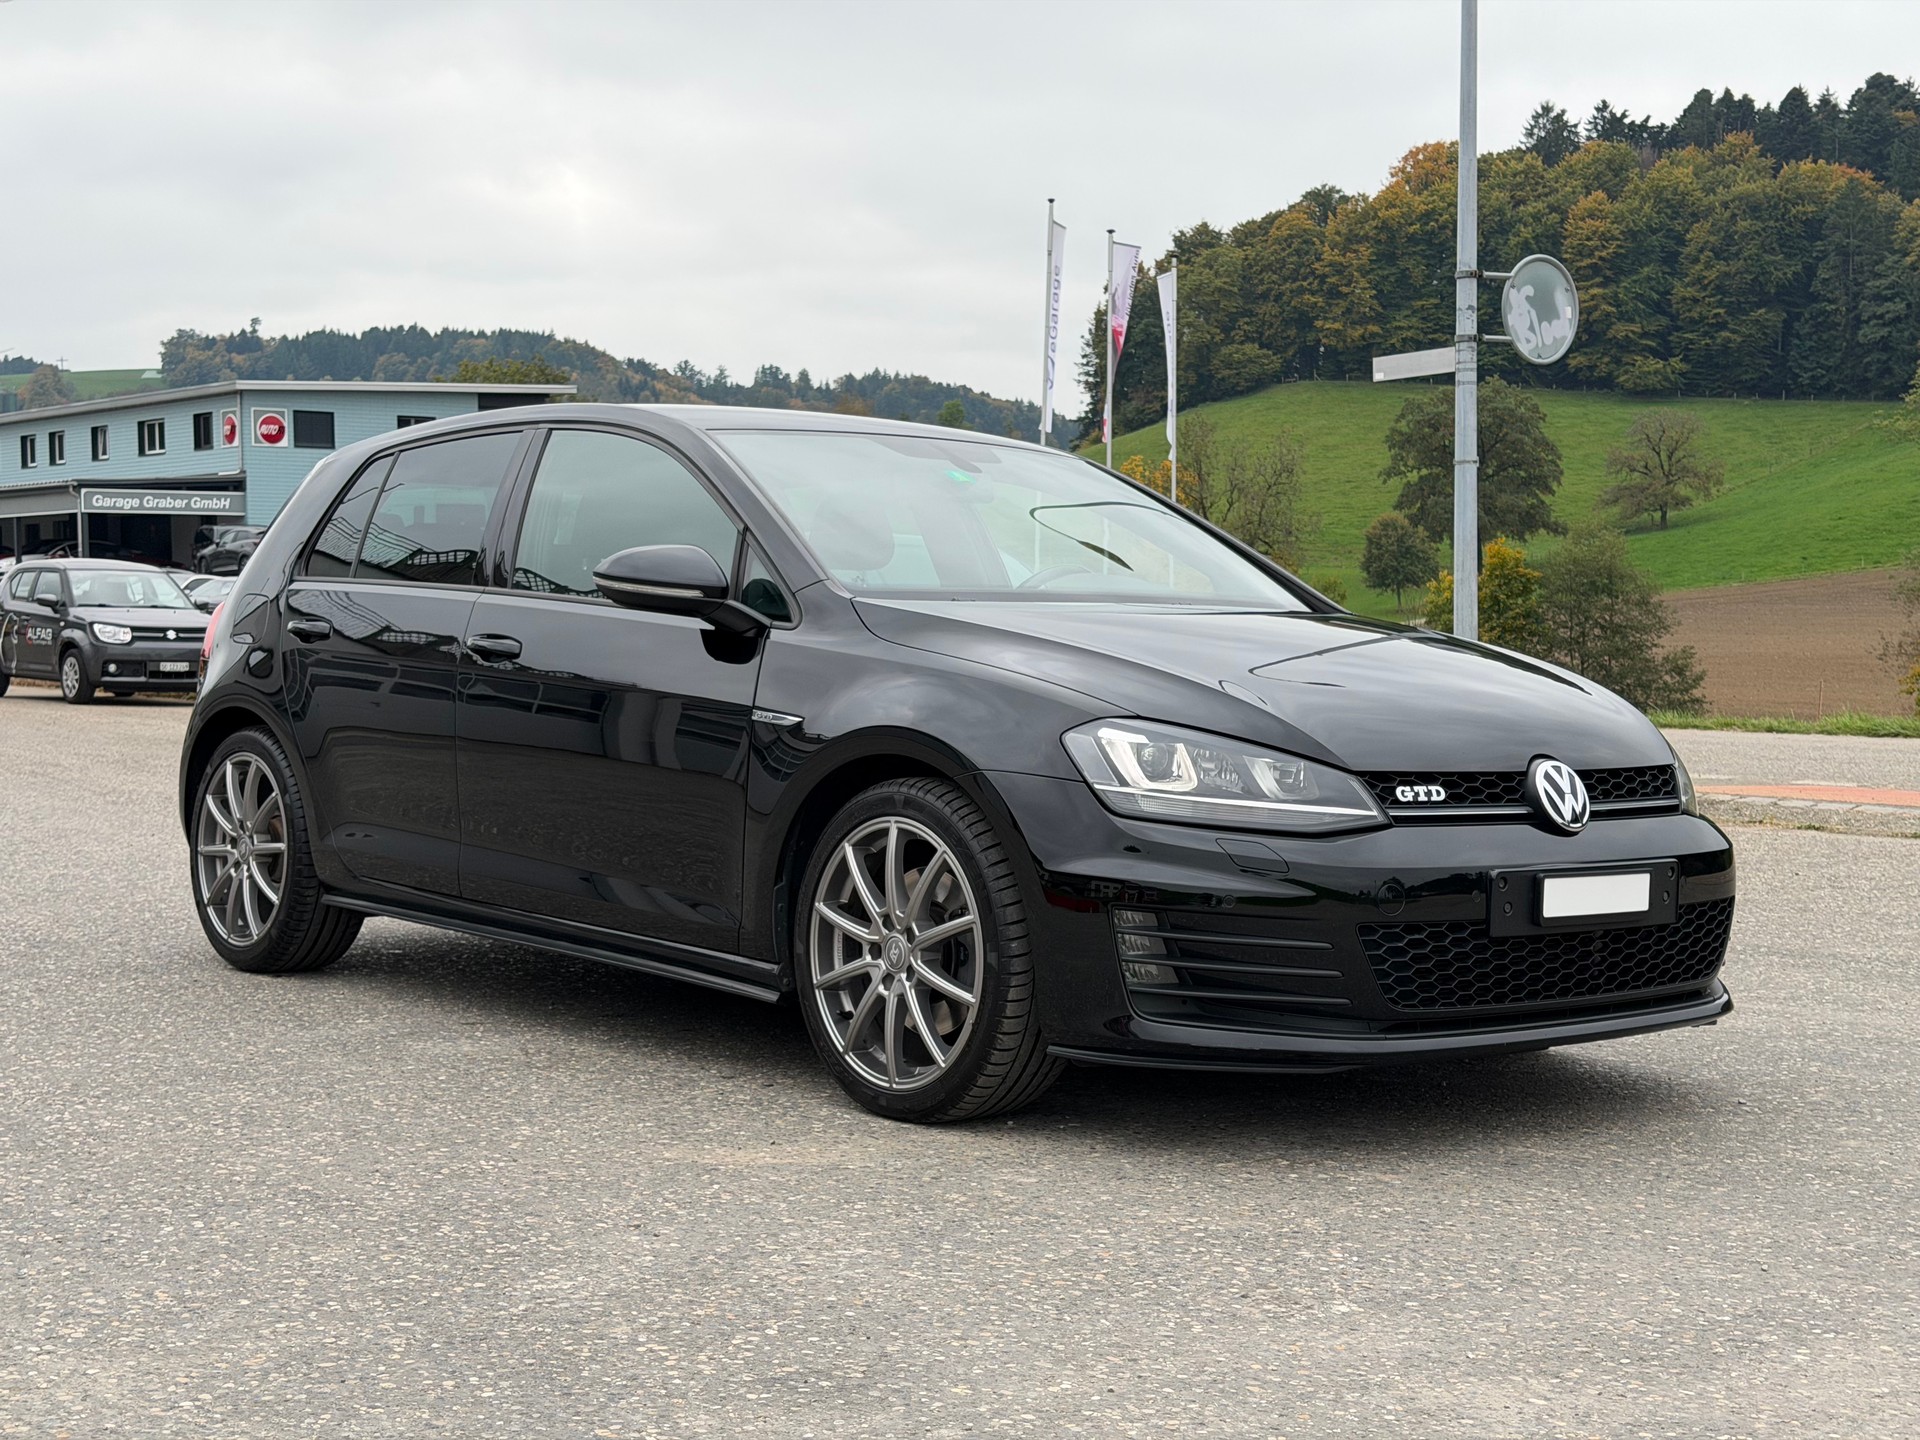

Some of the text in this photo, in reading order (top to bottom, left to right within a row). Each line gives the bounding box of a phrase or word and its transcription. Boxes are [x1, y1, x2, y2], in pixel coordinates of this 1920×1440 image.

[1048, 265, 1061, 353] eGarage
[92, 494, 231, 510] Garage Graber GmbH
[1395, 785, 1446, 802] GTD
